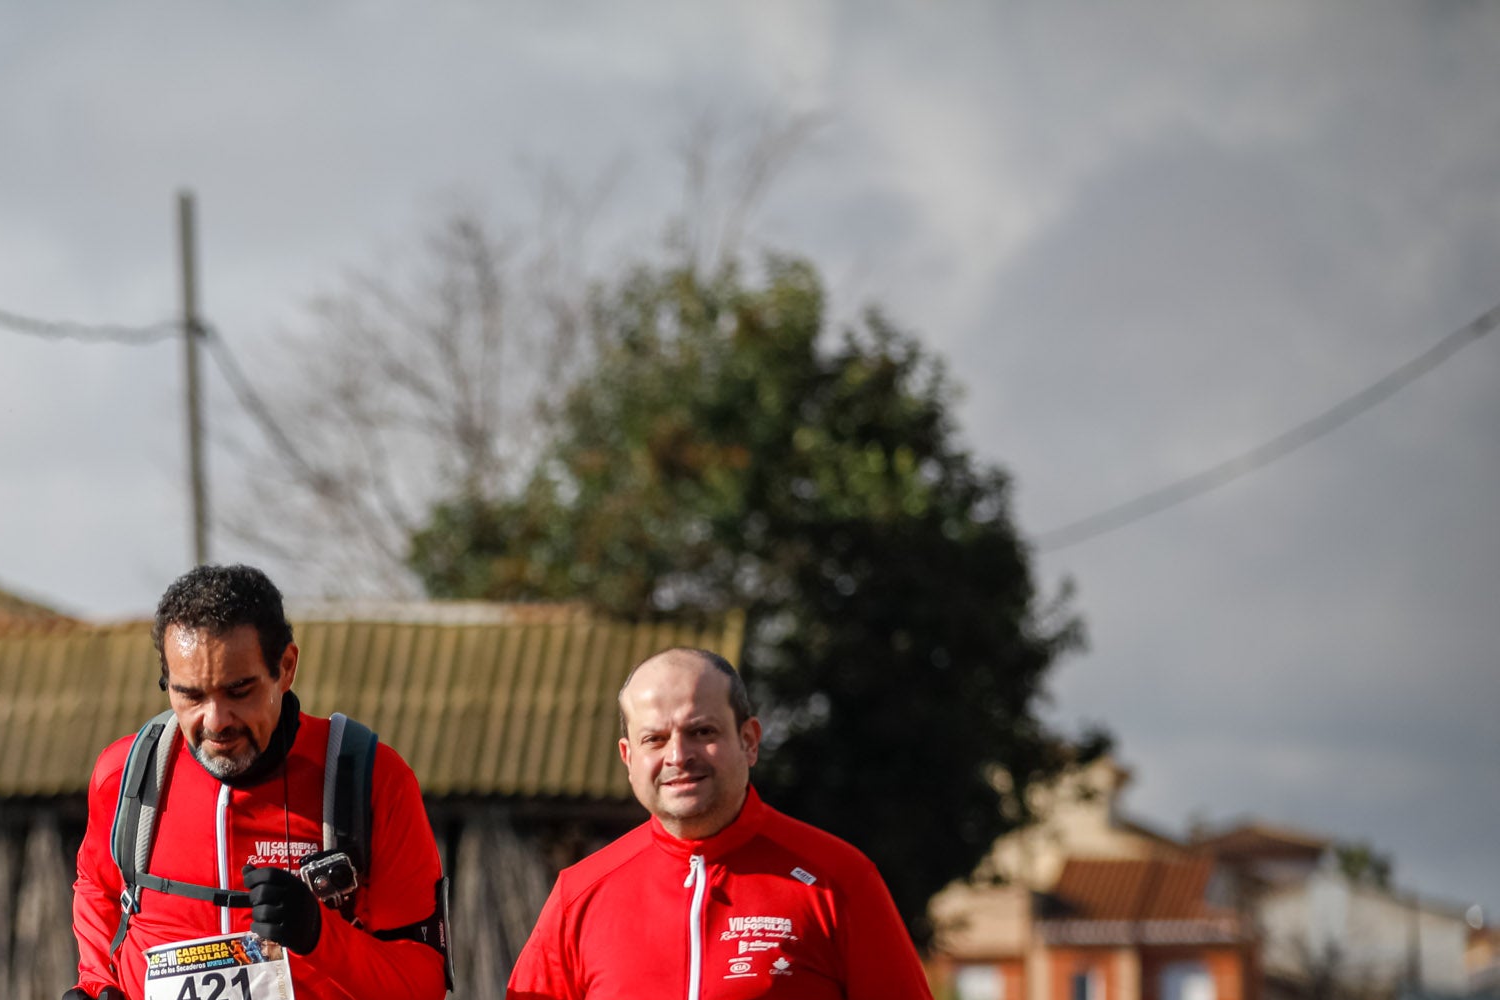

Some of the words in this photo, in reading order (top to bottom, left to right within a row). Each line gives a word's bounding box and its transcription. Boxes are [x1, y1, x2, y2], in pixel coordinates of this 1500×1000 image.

[255, 841, 270, 856] VII
[268, 855, 278, 863] de
[728, 917, 744, 931] VII
[744, 916, 792, 925] CARRERA
[744, 923, 792, 932] POPULAR
[176, 942, 229, 957] CARRERA
[177, 950, 229, 964] POPULAR
[176, 962, 206, 972] Secaderos
